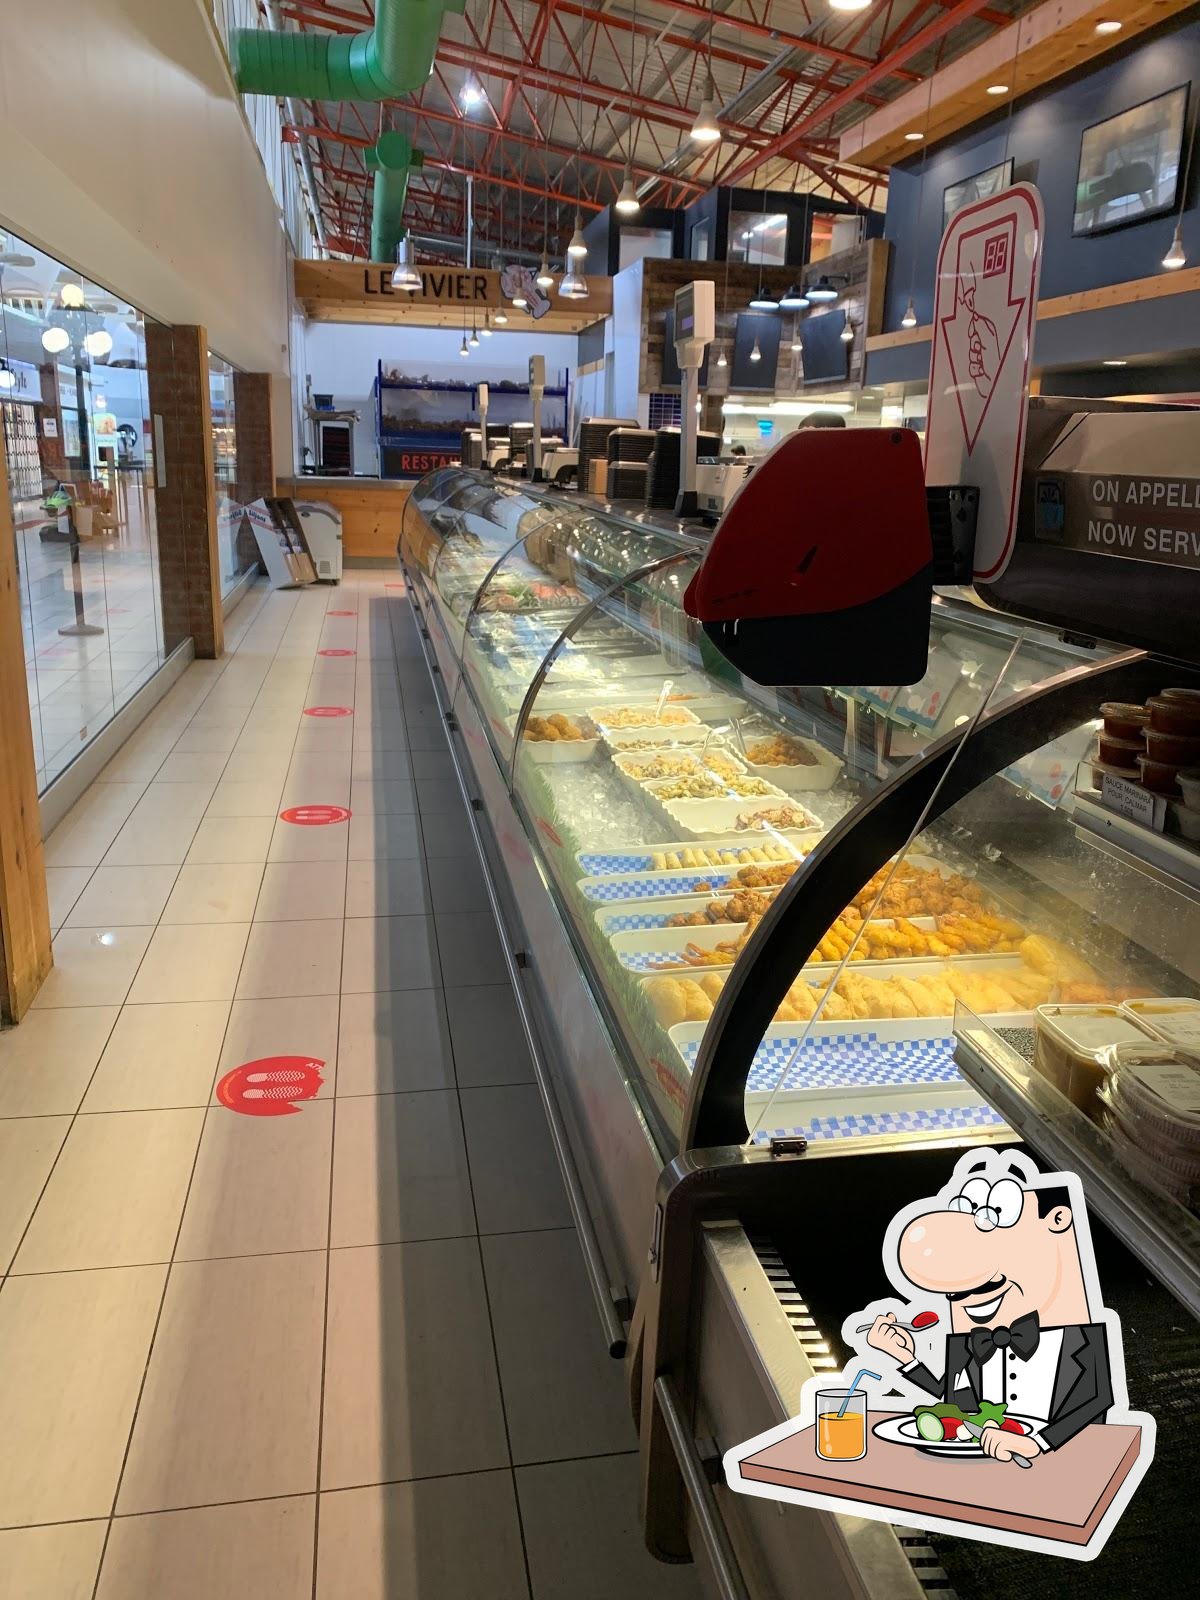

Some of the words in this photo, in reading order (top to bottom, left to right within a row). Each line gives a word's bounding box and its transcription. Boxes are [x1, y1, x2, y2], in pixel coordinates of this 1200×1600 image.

[364, 269, 394, 295] LE
[402, 272, 488, 300] IVIER
[1092, 479, 1119, 502] ON
[1088, 520, 1136, 548] NOW
[1104, 776, 1123, 791] SAUCE
